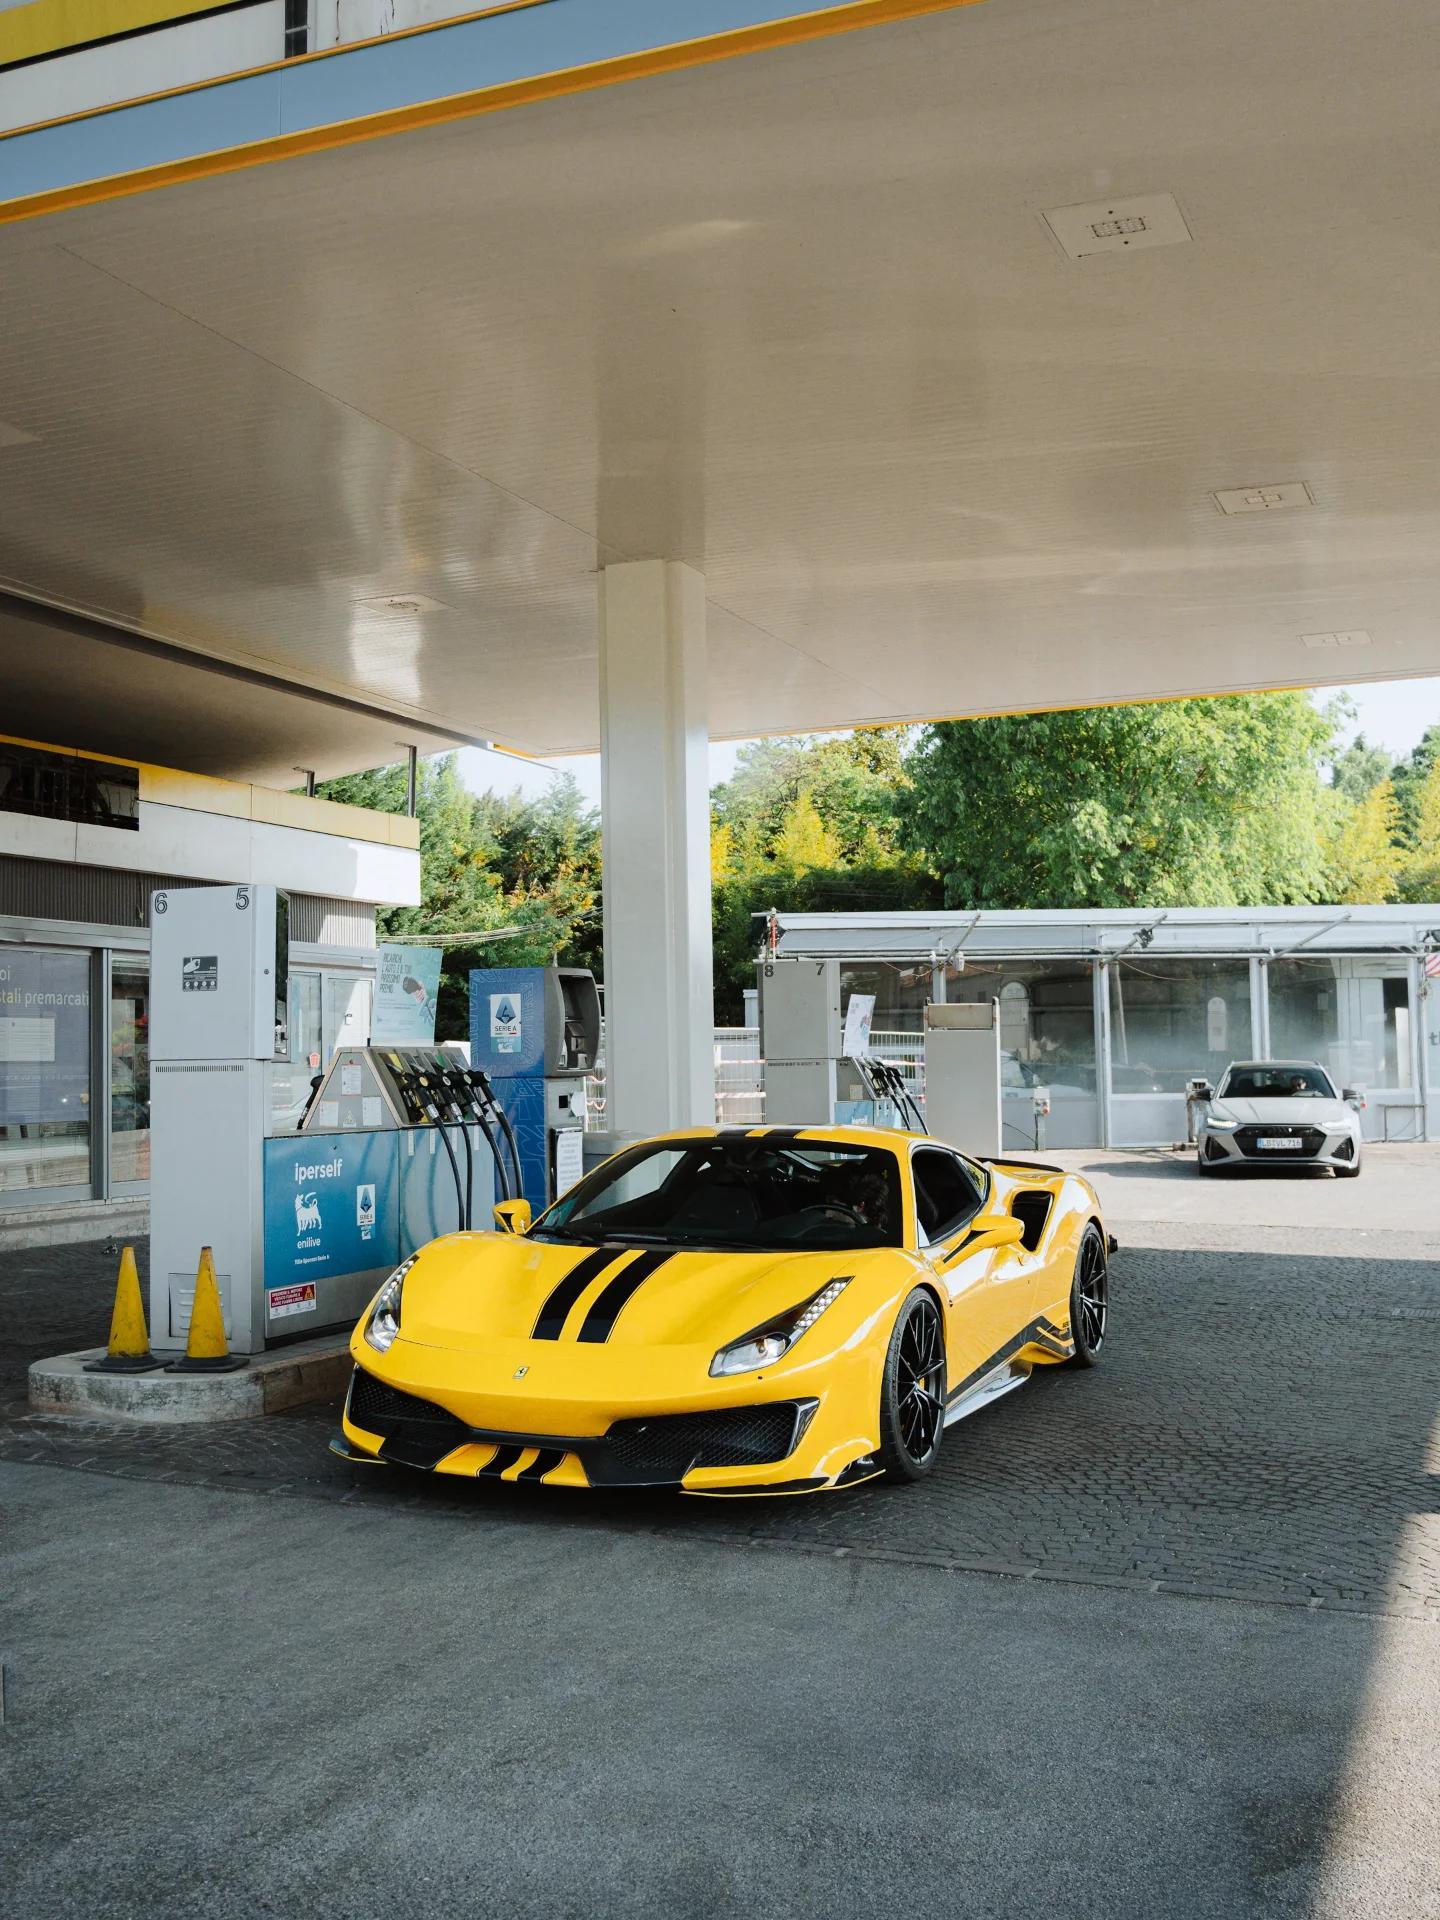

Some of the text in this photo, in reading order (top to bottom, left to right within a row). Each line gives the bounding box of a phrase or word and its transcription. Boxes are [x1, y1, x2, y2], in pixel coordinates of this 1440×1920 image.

[155, 887, 250, 914] 6 5
[765, 963, 825, 977] 8 7
[25, 990, 89, 1008] premarcati
[295, 1158, 343, 1184] iperself
[297, 1236, 321, 1249] enilive
